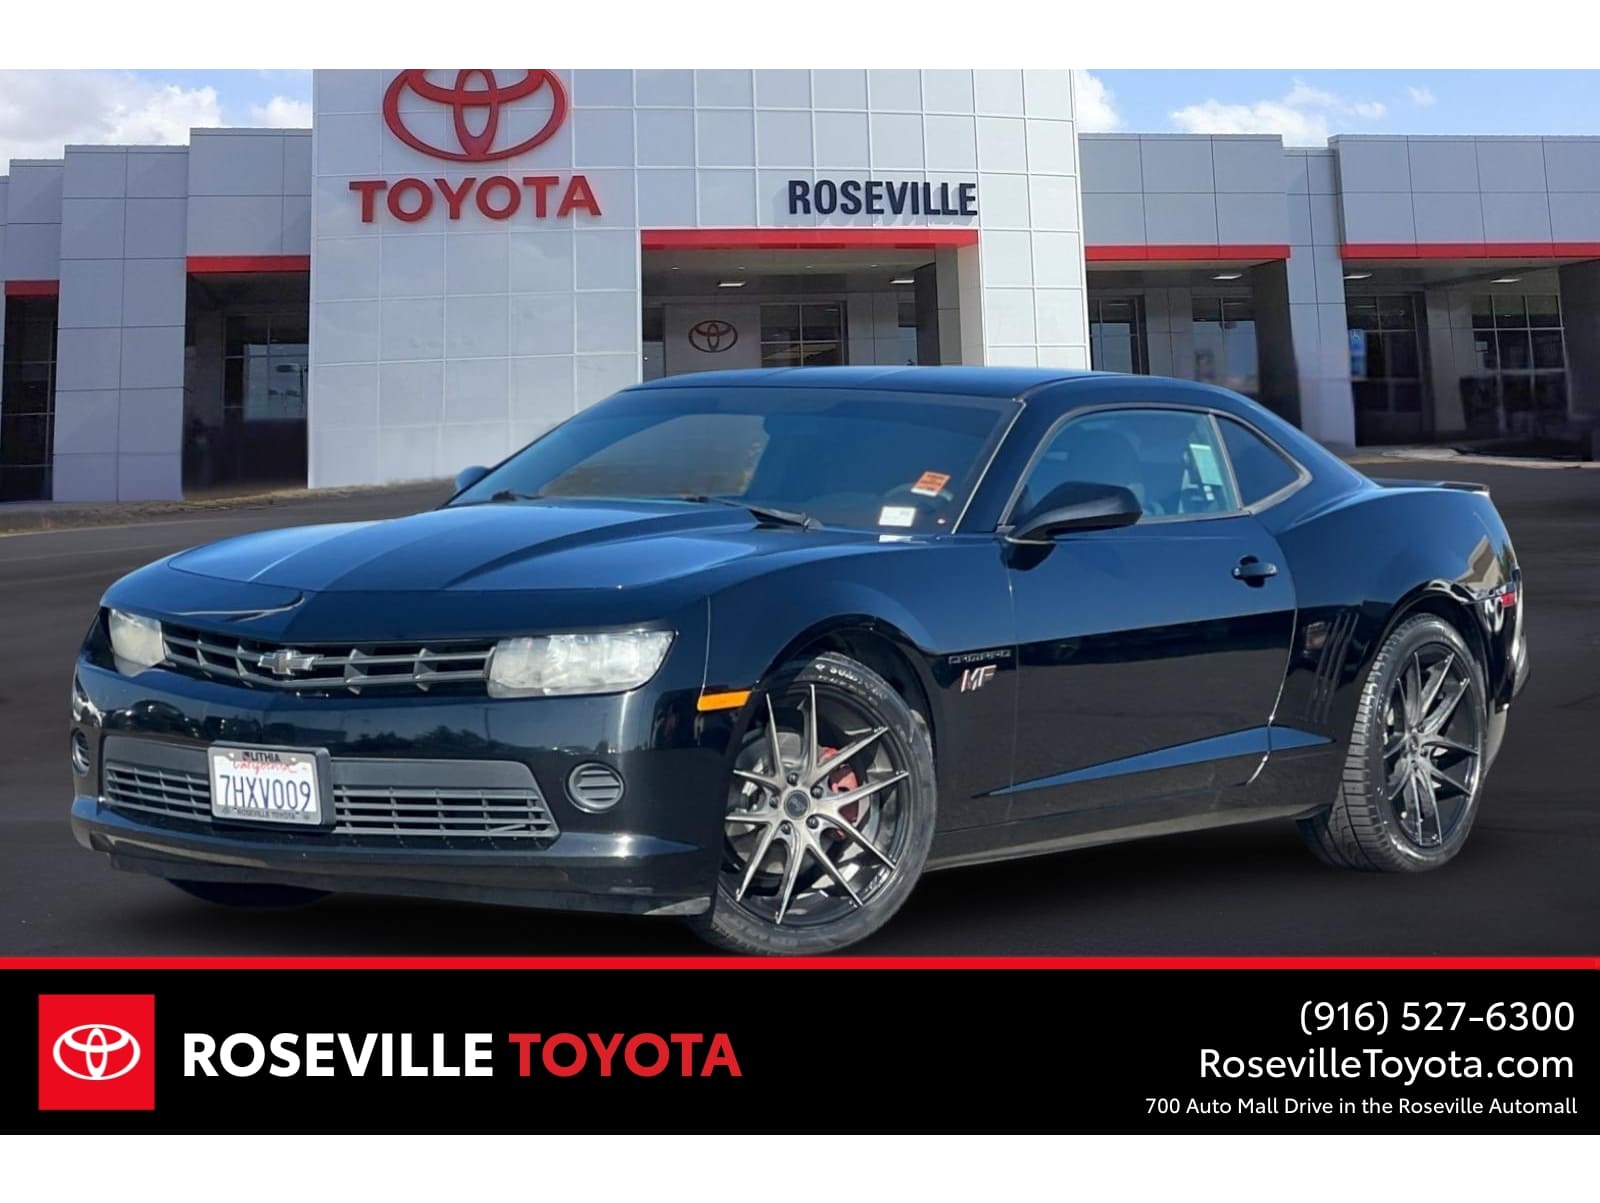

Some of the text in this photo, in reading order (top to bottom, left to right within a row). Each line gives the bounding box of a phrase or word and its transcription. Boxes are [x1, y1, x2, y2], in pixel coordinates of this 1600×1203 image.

[350, 175, 602, 223] TOYOTA
[788, 180, 979, 217] ROSEVILLE
[250, 752, 281, 763] LITHIA
[219, 774, 312, 811] 7HXV009
